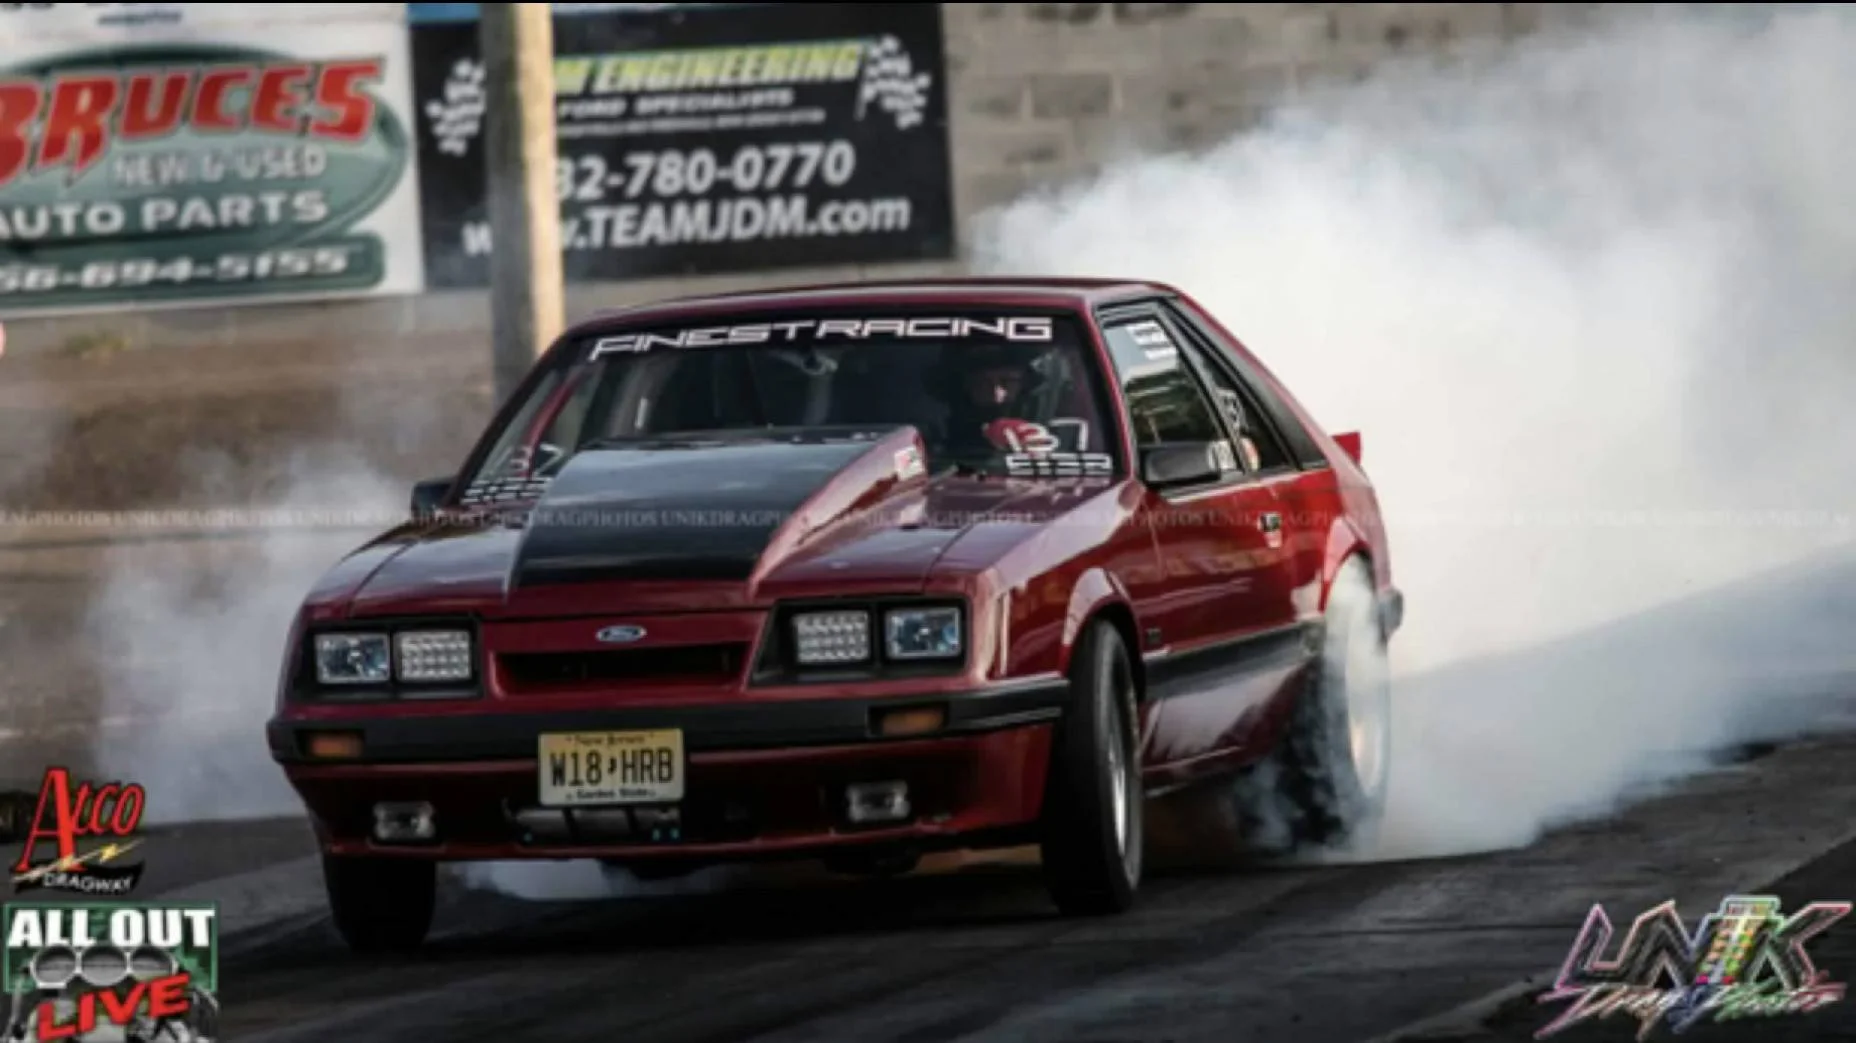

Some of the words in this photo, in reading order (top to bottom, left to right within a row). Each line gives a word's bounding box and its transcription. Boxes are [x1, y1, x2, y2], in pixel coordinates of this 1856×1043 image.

[591, 42, 864, 92] ENGINEERING
[633, 87, 796, 115] SPECIALISTS
[0, 58, 384, 187] BRUCES
[113, 153, 190, 188] NEW
[235, 146, 327, 180] USED
[140, 189, 330, 231] PARTS
[1003, 417, 1089, 453] 137
[550, 751, 602, 787] W18
[621, 747, 674, 785] HRB
